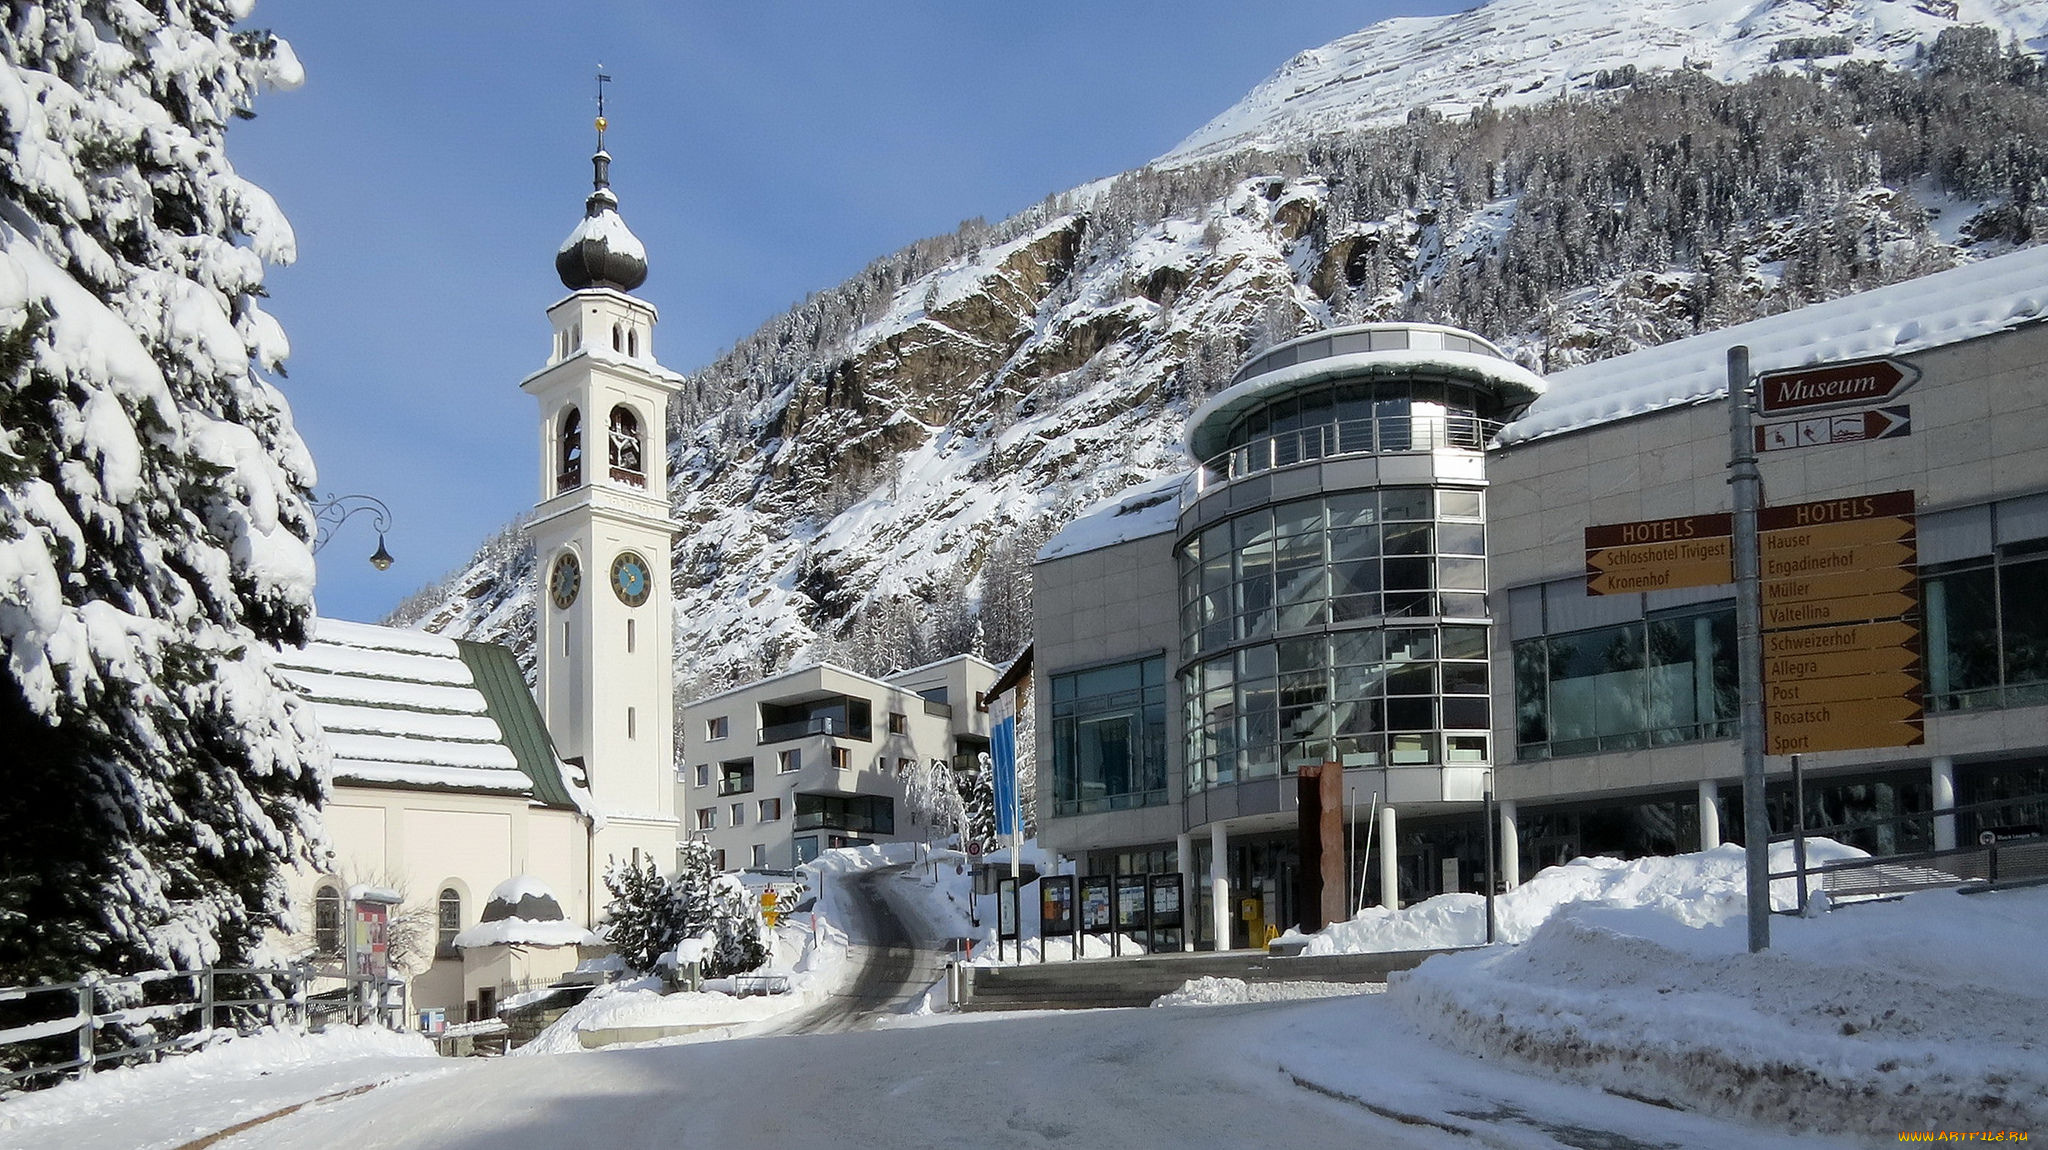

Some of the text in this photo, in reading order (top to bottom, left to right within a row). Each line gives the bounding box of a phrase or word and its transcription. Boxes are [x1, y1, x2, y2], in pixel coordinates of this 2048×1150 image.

[1778, 376, 1876, 402] Museum
[1796, 498, 1874, 525] HOTELS
[1623, 519, 1694, 542] HOTELS
[1767, 534, 1811, 550] Hauser
[1607, 543, 1725, 566] Schlosshotel Tivigest
[1768, 550, 1853, 577] Engadinerhof
[1608, 570, 1670, 590] Kronenhof
[1768, 582, 1810, 599] Müller
[1769, 605, 1830, 624] Valtellina
[1771, 629, 1856, 651] Schweizerhof
[1772, 661, 1817, 678] Allegra
[1773, 685, 1800, 700] Post
[1774, 706, 1830, 725] Rosatsch
[1774, 735, 1809, 754] Sport
